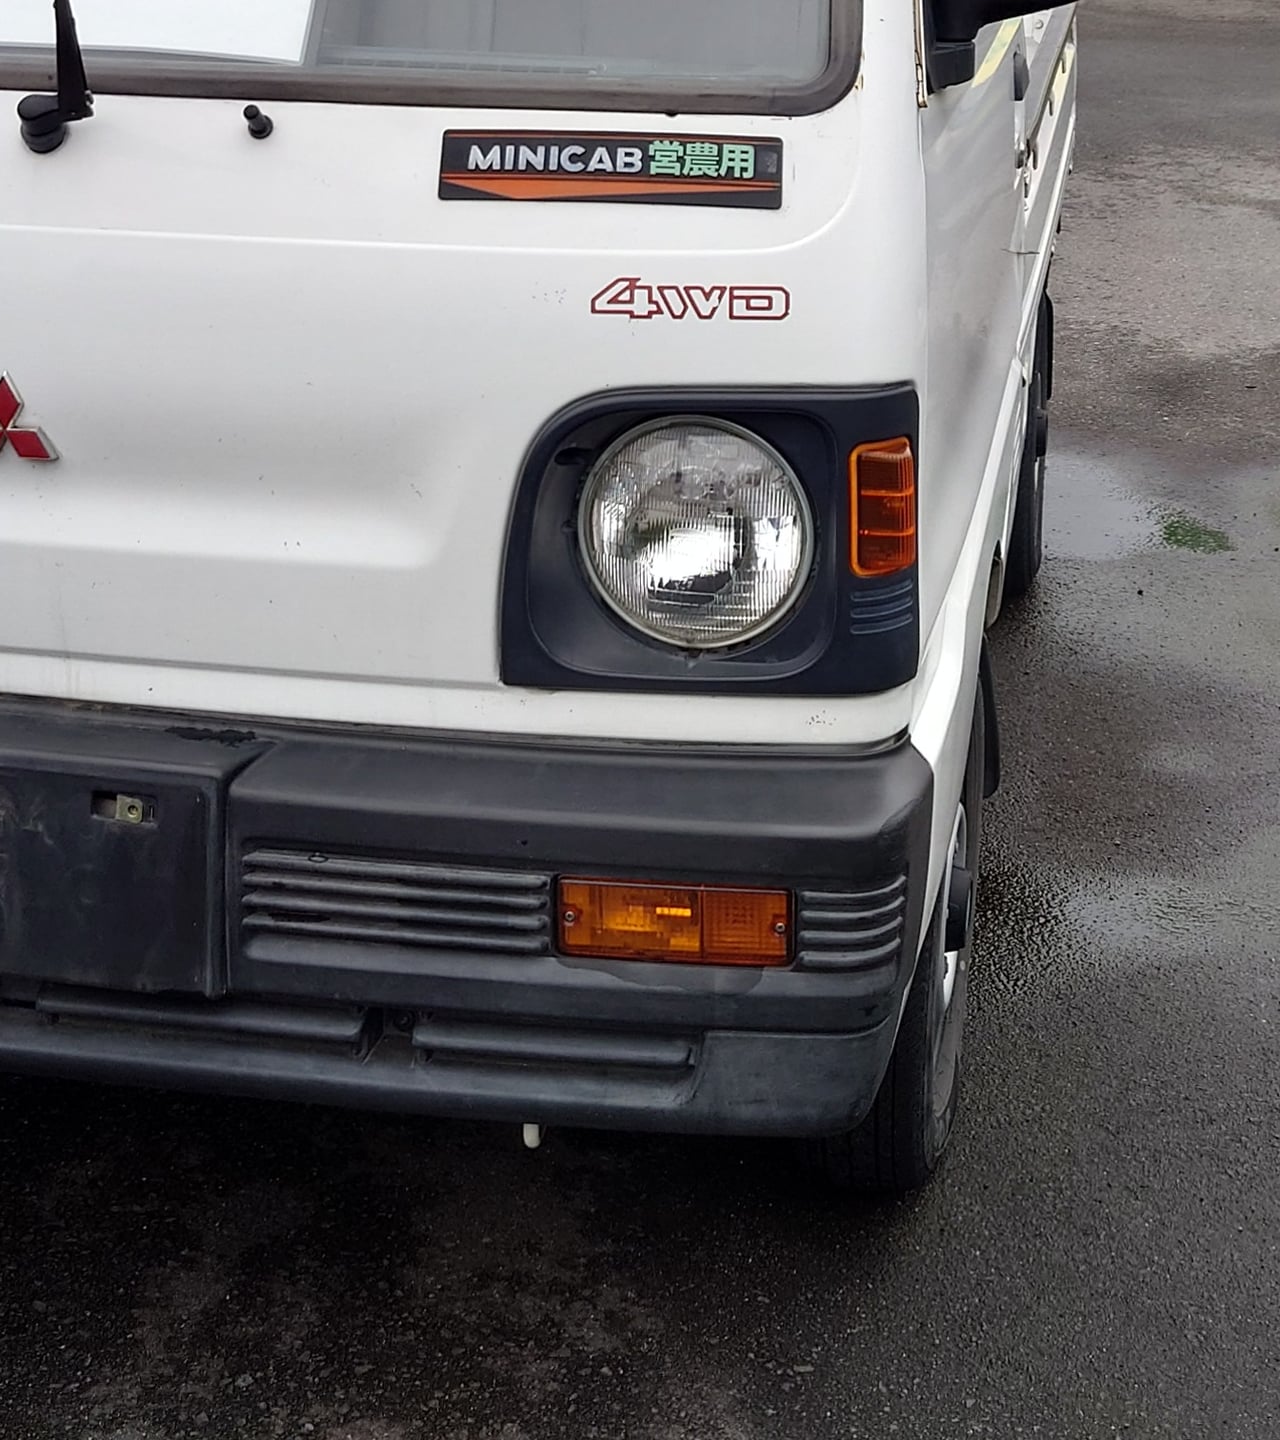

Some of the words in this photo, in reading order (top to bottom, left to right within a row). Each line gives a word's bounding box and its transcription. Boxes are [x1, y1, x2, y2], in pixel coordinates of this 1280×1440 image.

[467, 144, 643, 174] MINICAB
[648, 139, 756, 179] 営農用
[591, 277, 791, 320] 4WD
